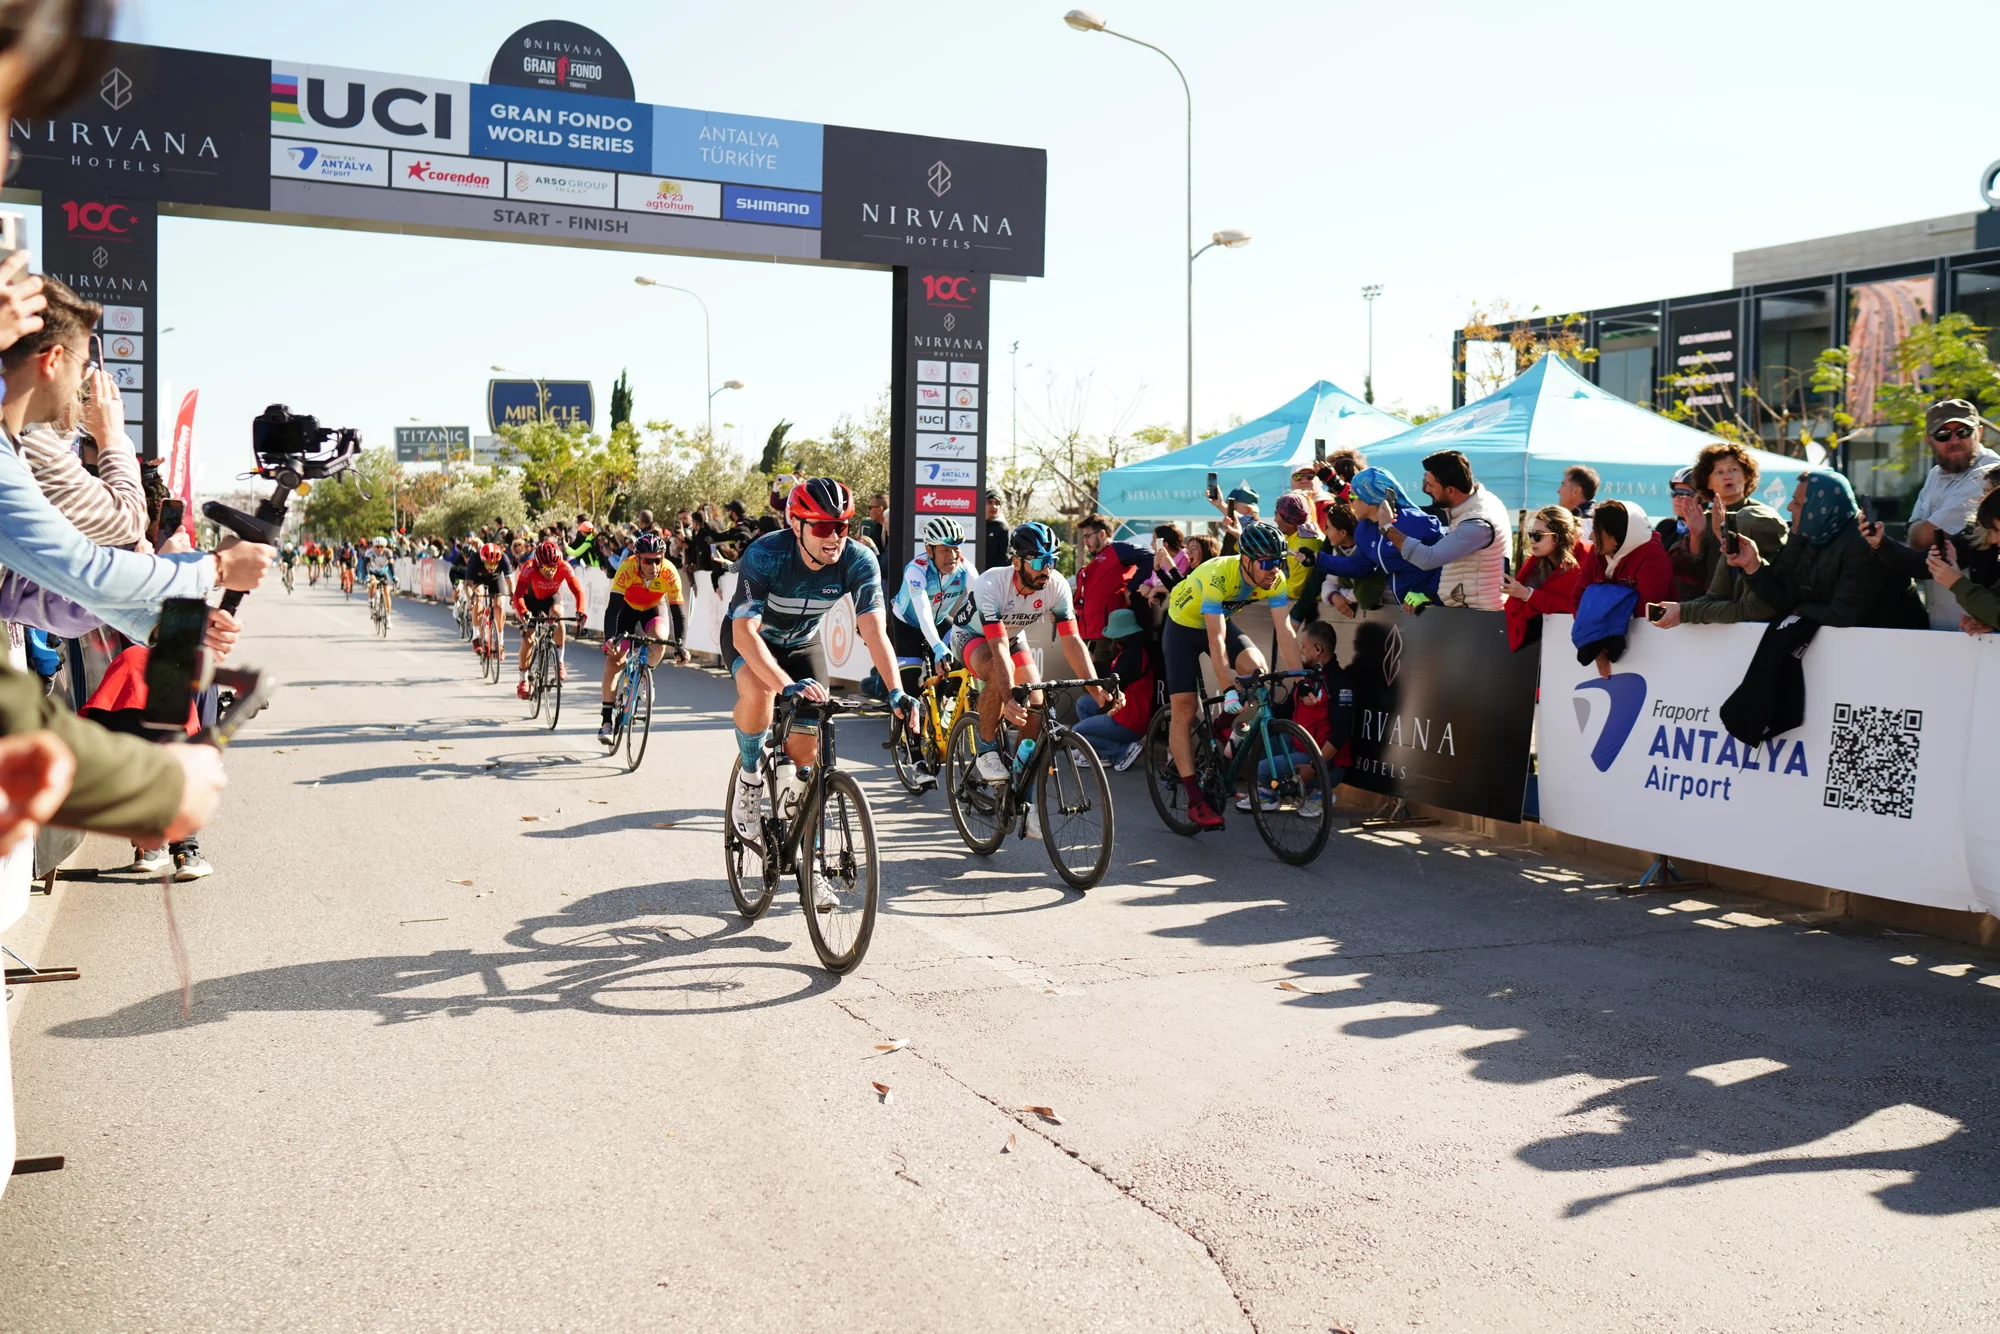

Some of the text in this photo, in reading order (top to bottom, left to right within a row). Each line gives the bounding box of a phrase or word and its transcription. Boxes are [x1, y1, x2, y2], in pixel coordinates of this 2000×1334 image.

[533, 39, 603, 57] NIRVANA
[523, 56, 602, 80] GRAN FONDO
[306, 77, 452, 140] UCI
[490, 103, 633, 132] GRAN FONDO
[8, 117, 219, 158] NIRVANA
[487, 125, 635, 154] WORLD SERIES
[699, 125, 779, 148] ANTALYA
[71, 154, 161, 173] HOTELS
[321, 160, 373, 172] ANTALYA
[700, 146, 778, 170] TÜRKİYE
[321, 168, 351, 177] Airport
[428, 169, 490, 185] corendon
[646, 199, 694, 212] agtohum
[736, 197, 810, 215] SHIMANO
[493, 209, 550, 227] START
[568, 216, 628, 234] FINISH
[862, 203, 1013, 236] NIRVANA
[905, 235, 970, 250] HOTELS
[79, 291, 121, 300] HOTELS
[914, 335, 983, 350] NIRVANA
[919, 388, 940, 400] TGA
[923, 416, 943, 425] UCI
[400, 430, 464, 442] TITANIC
[1126, 490, 1171, 501] NIRVANA
[1604, 481, 1656, 495] RVANA
[934, 497, 970, 507] corendon
[1652, 700, 1710, 724] Fraport
[1361, 708, 1456, 757] RVANA
[1648, 725, 1809, 778] ANTALYA
[1355, 756, 1407, 780] HOTELS
[1644, 765, 1732, 801] Airport
